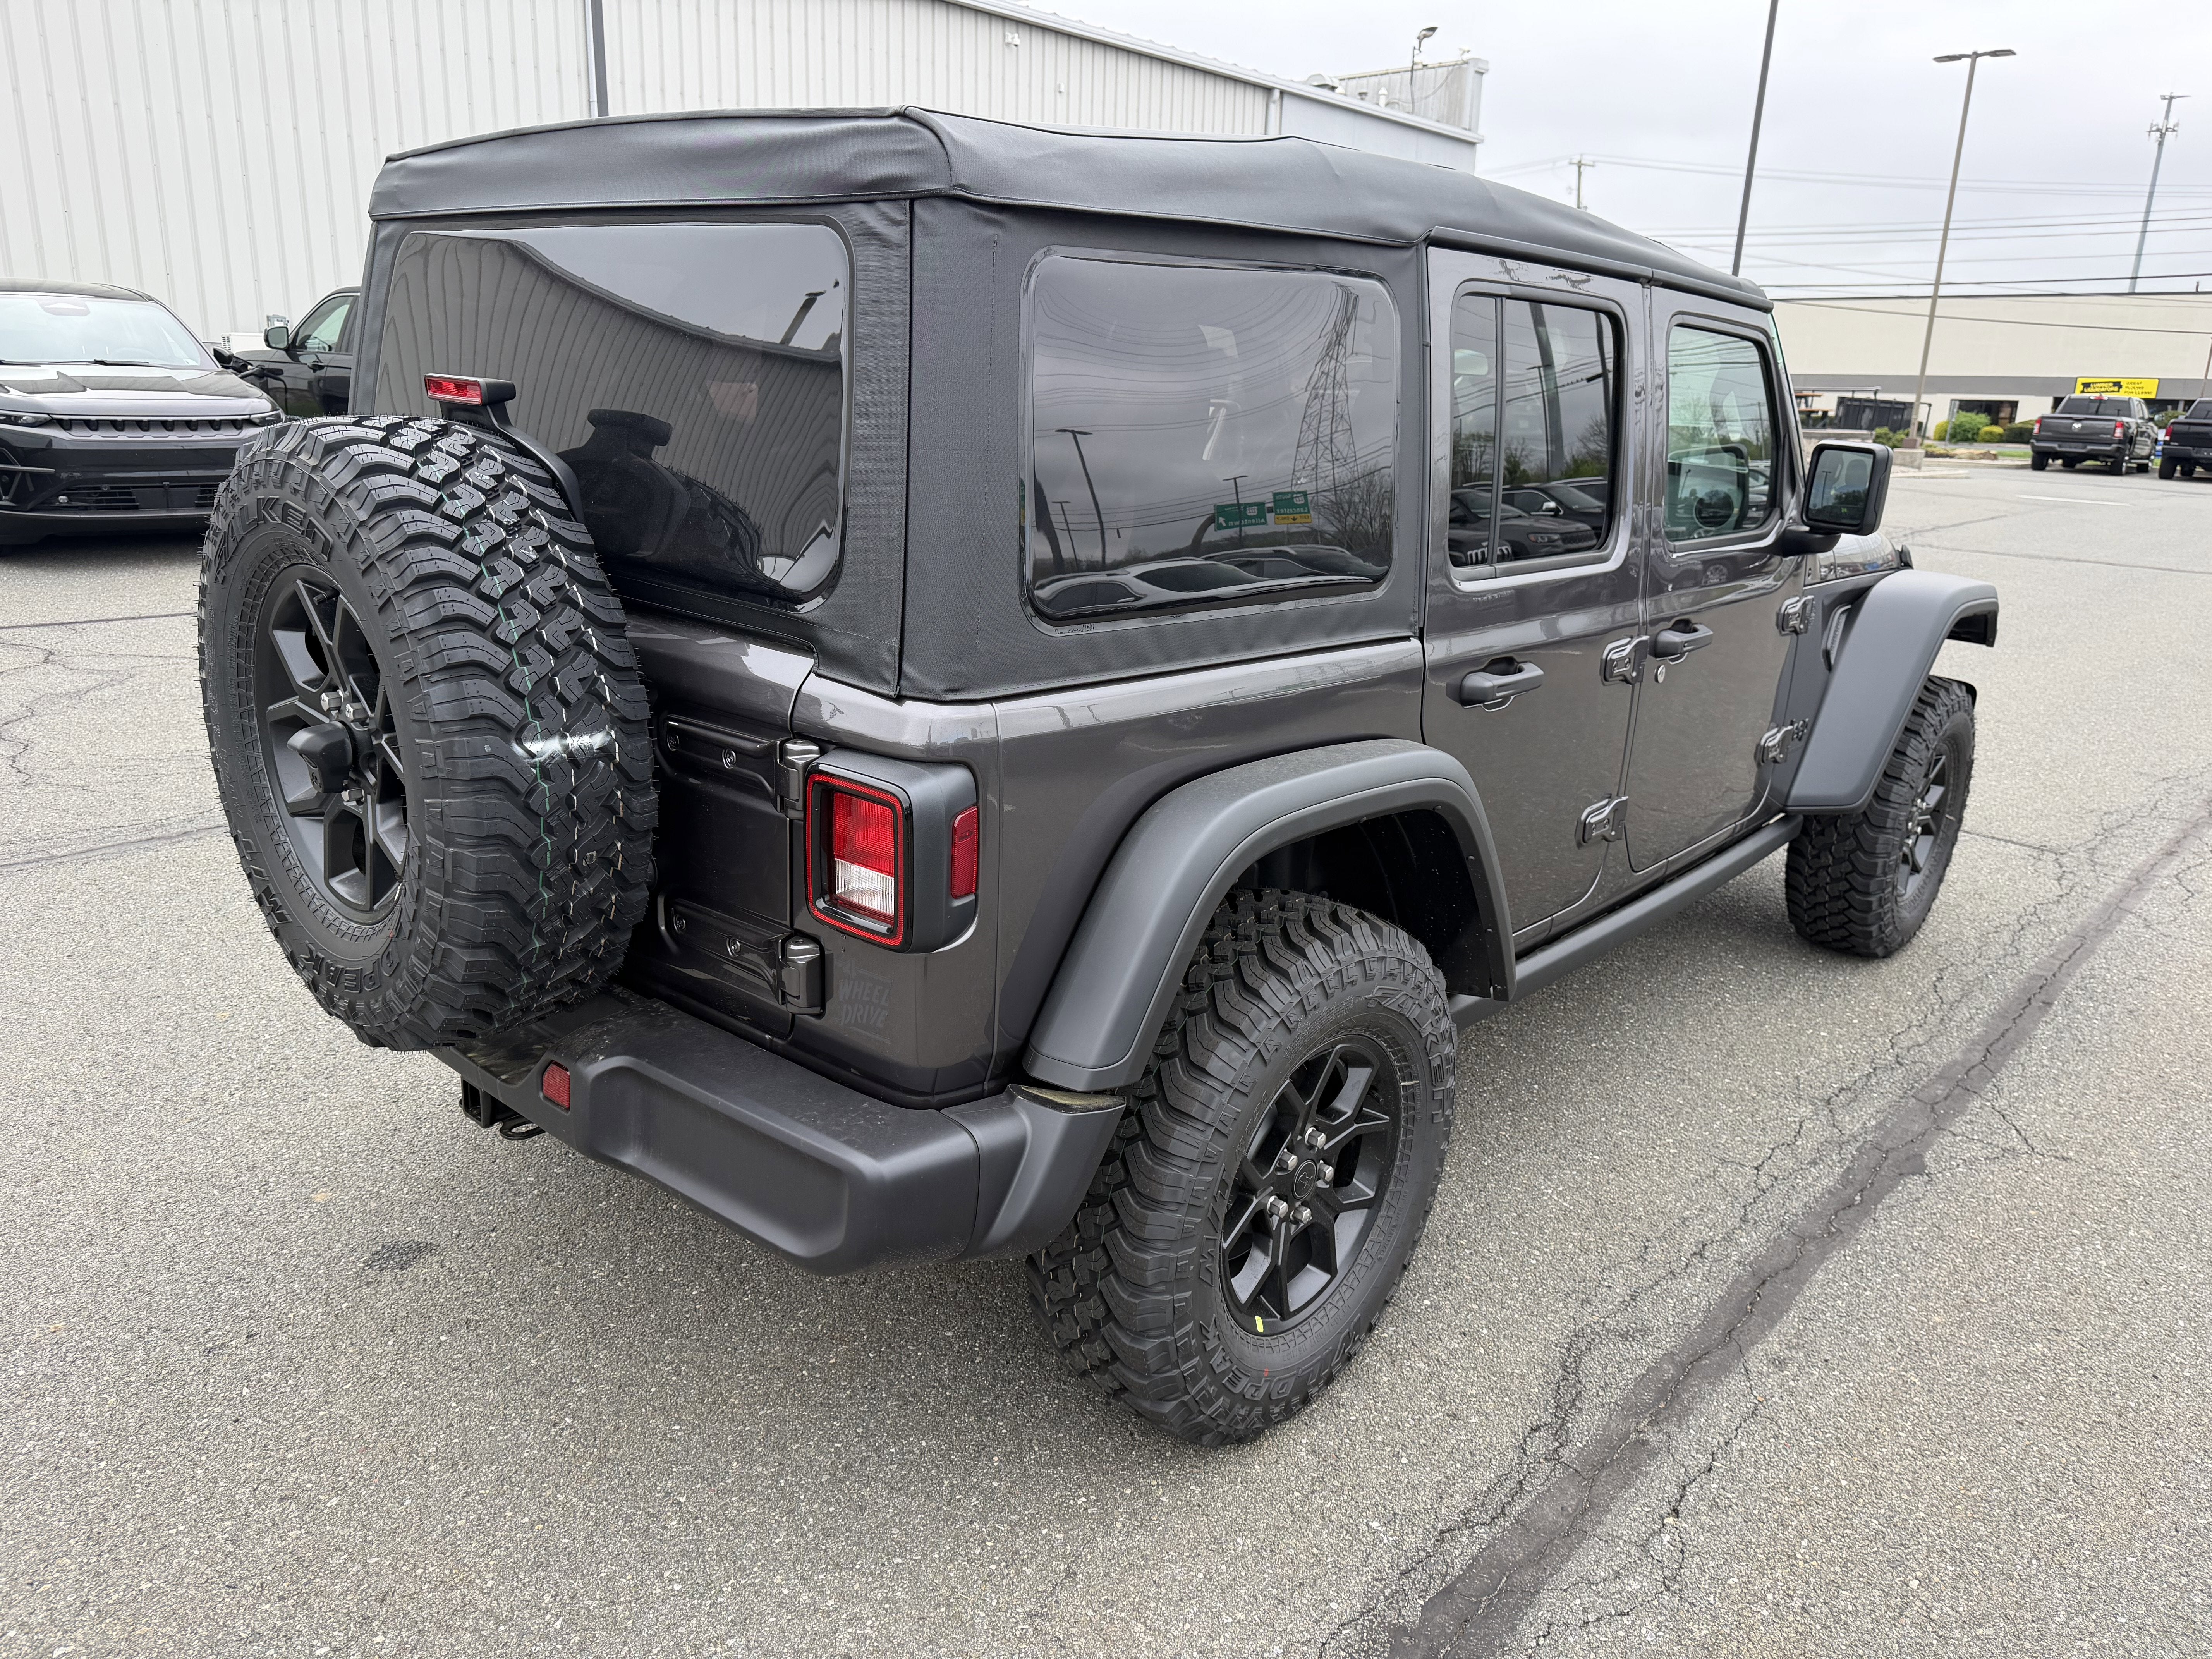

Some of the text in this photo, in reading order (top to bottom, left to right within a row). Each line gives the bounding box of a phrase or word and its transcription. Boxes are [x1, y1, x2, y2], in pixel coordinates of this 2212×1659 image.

[839, 979, 889, 1006] WHEEL
[840, 1003, 888, 1028] DRIVE
[1200, 1314, 1363, 1401] WILDPEAK
